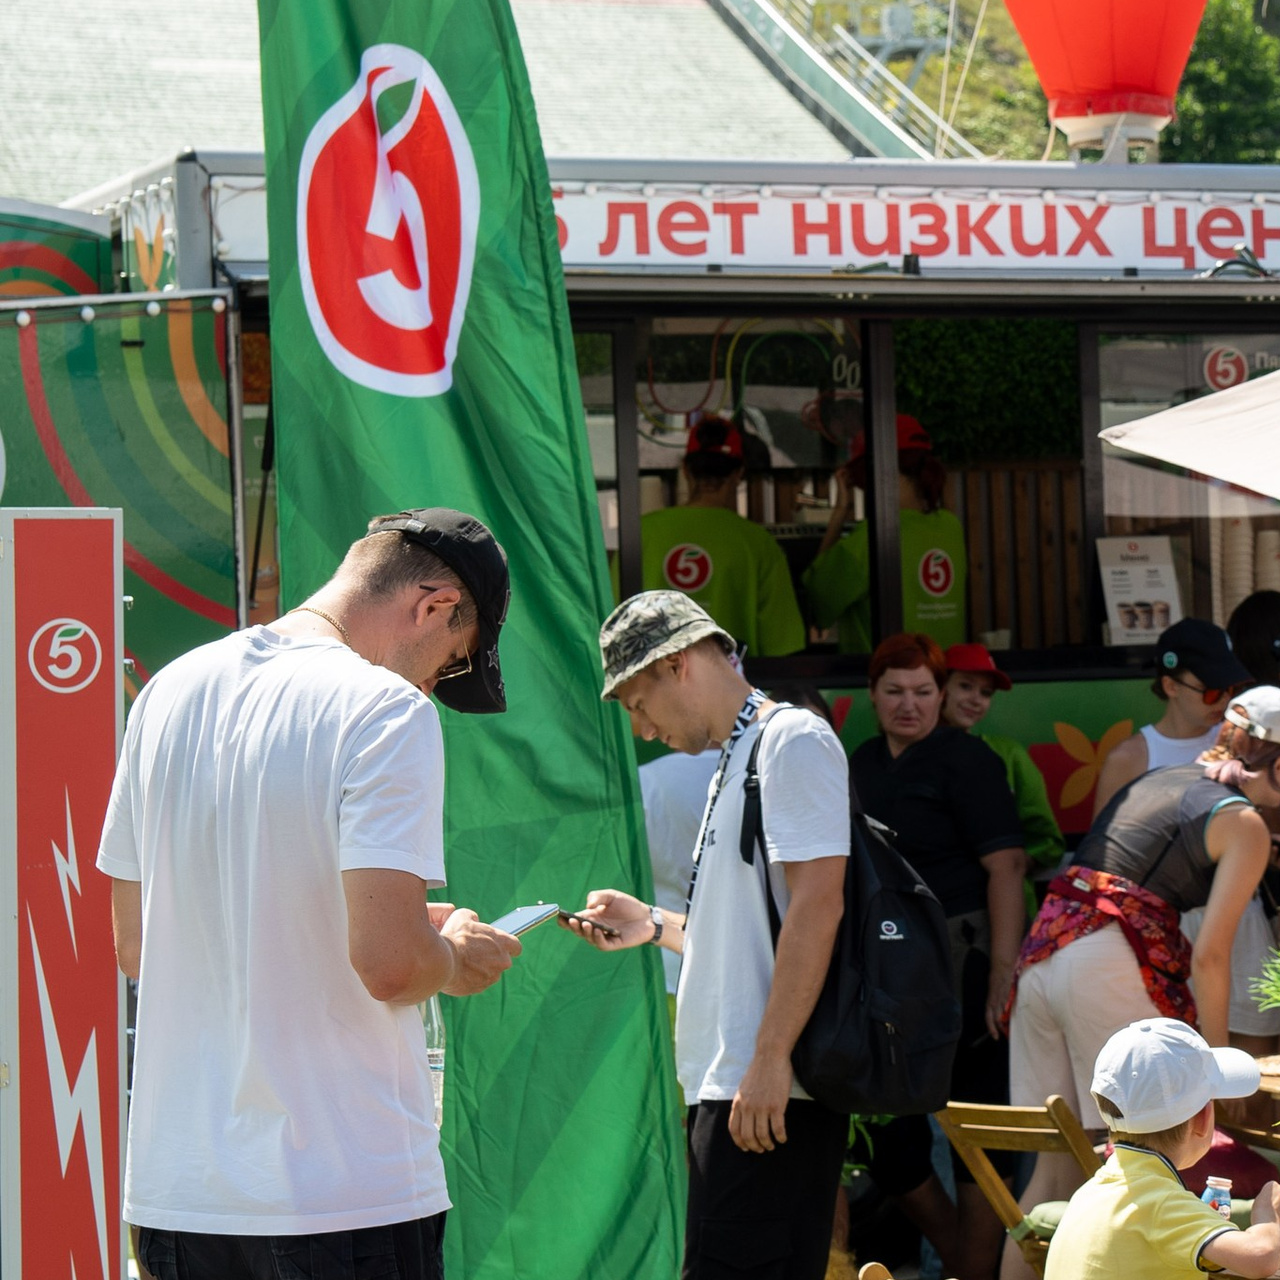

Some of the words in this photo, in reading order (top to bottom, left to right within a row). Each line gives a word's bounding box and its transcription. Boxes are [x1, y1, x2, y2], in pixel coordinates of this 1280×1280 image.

[599, 201, 759, 256] лет
[791, 202, 1113, 257] низких
[47, 624, 85, 679] 5
